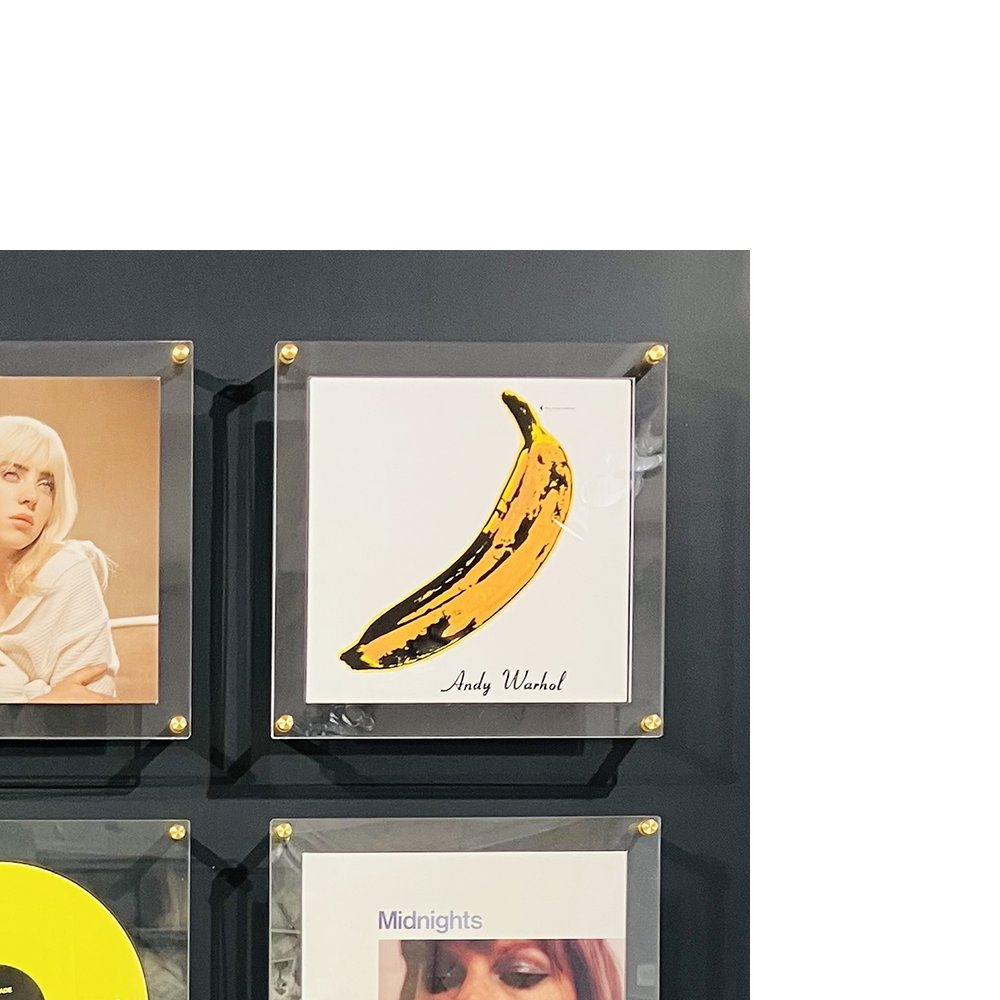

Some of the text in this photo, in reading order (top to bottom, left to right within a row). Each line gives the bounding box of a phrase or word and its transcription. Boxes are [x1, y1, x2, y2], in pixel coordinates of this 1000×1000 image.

[440, 669, 567, 696] Andy Warhol
[378, 910, 483, 934] Midnights
